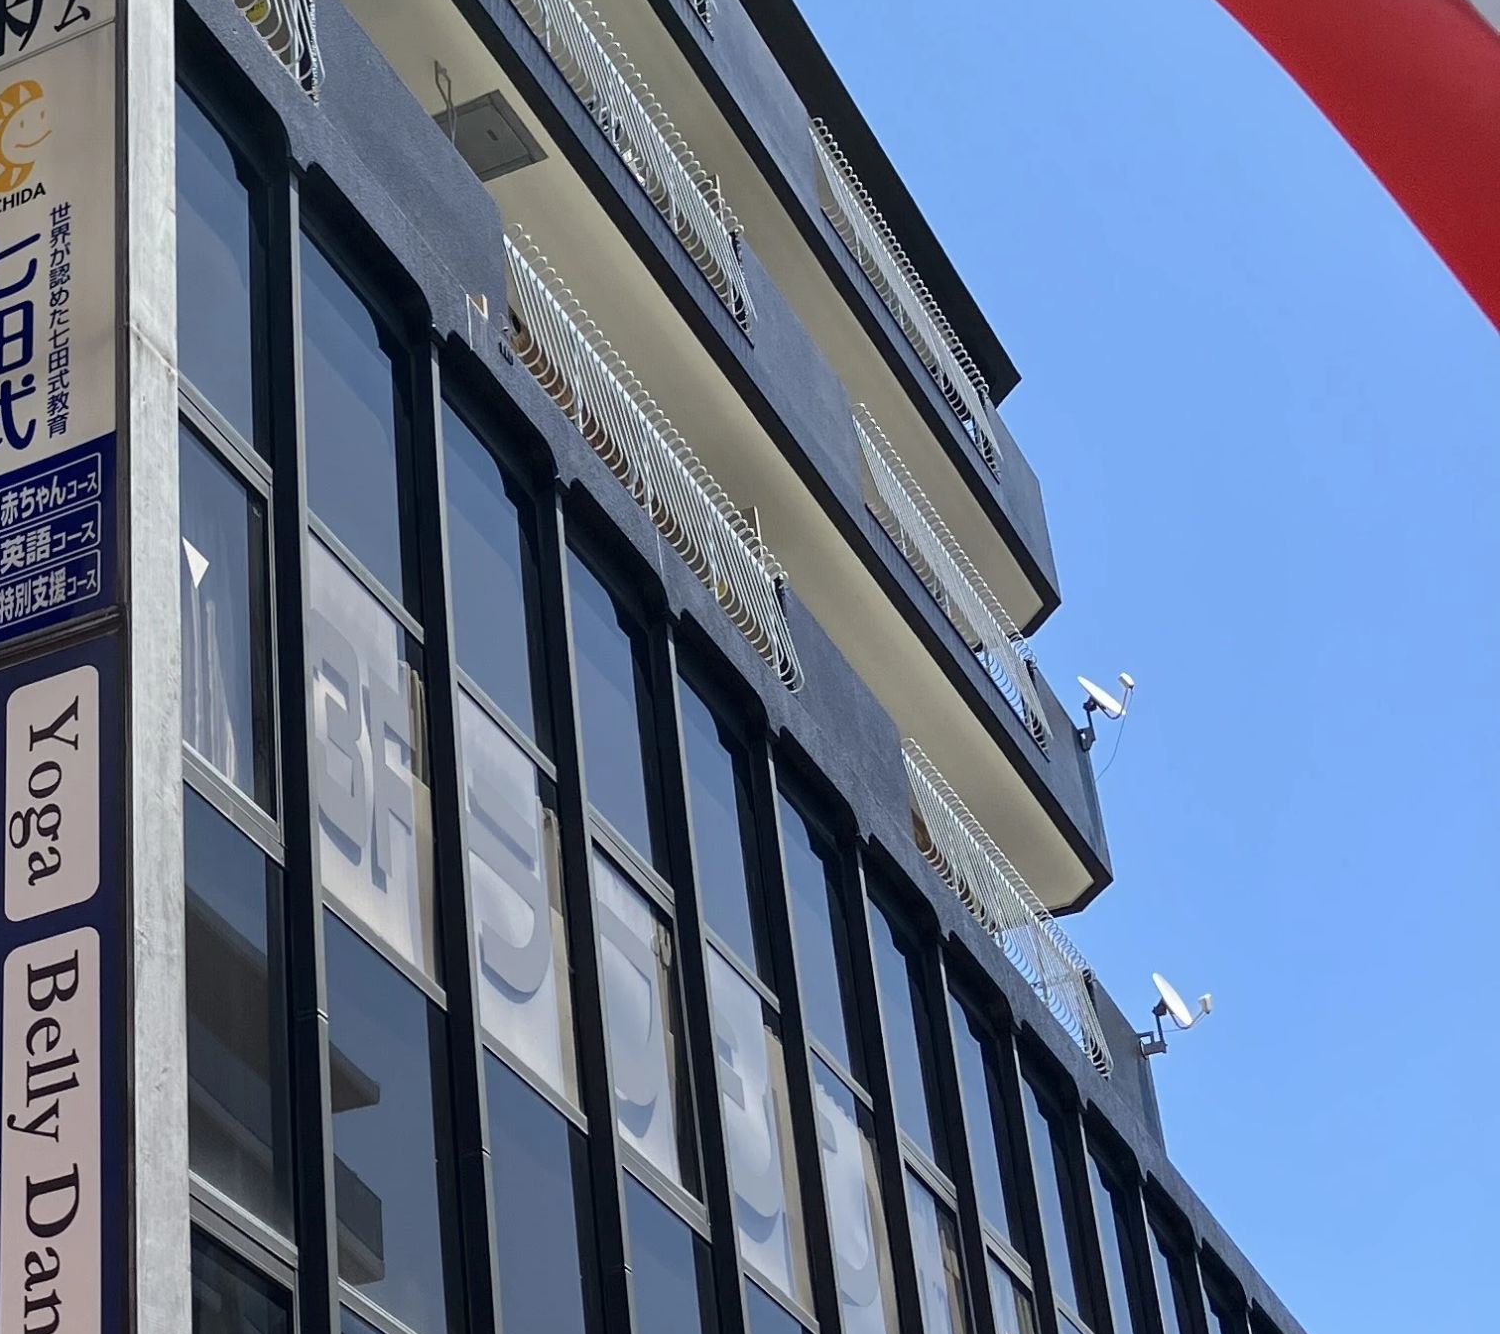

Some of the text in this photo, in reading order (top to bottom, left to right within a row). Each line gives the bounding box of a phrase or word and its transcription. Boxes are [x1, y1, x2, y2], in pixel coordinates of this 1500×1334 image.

[47, 200, 72, 437] 世界が認めた七田式教育
[0, 471, 98, 528] 赤ちゃんコース
[0, 520, 97, 575] 英語コース
[7, 695, 81, 888] Yoga
[7, 948, 81, 1145] Belly
